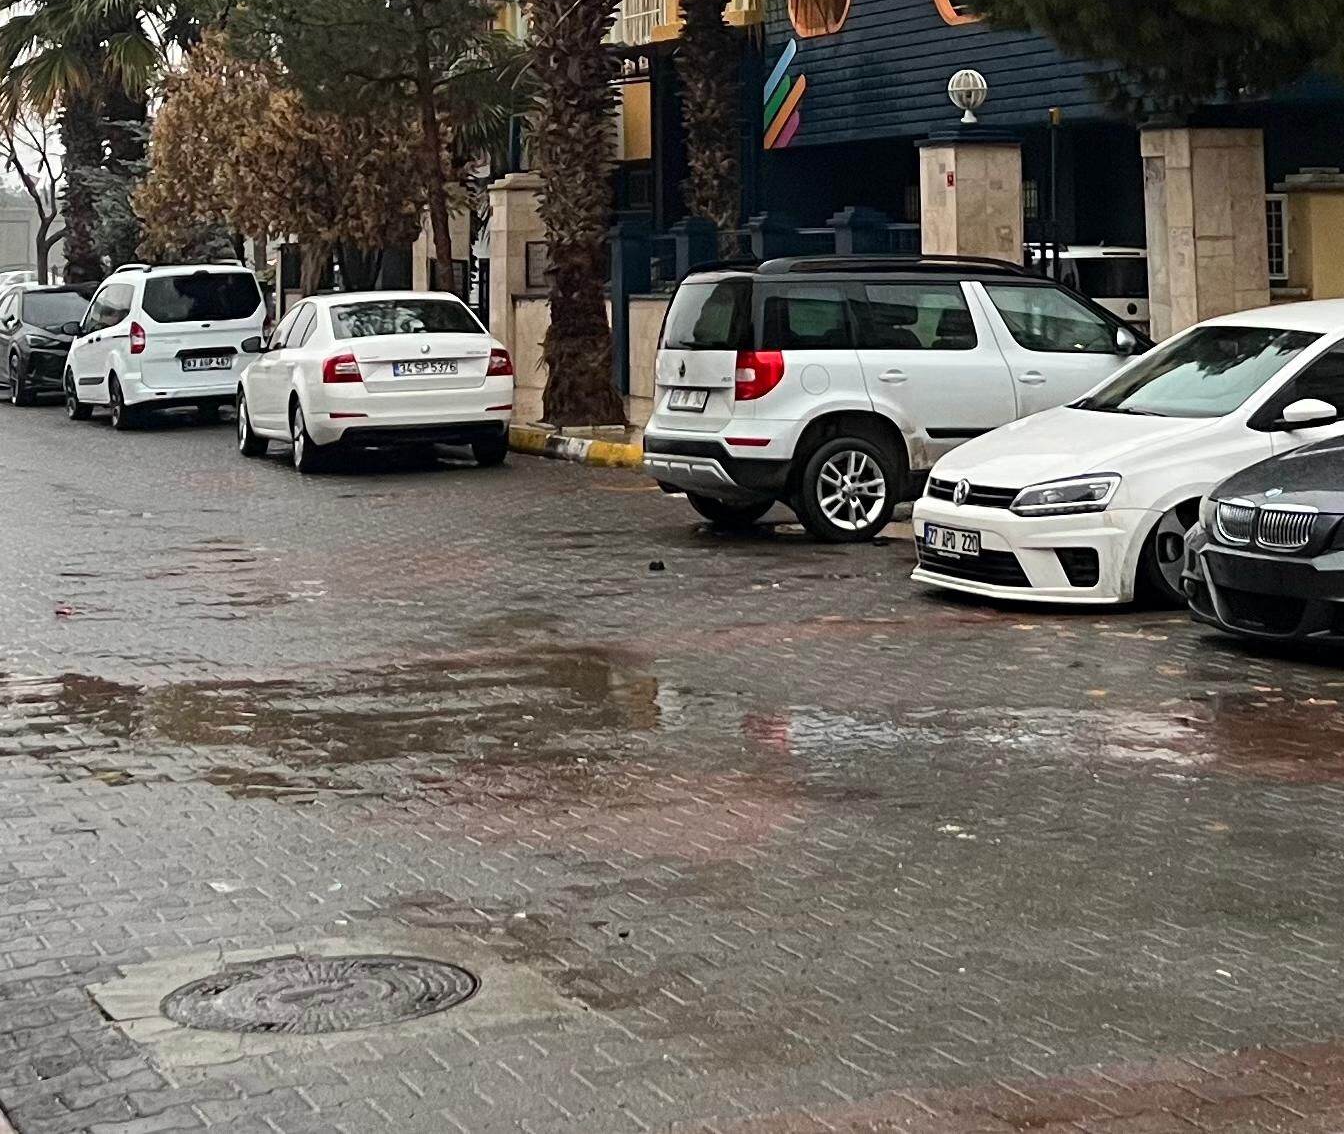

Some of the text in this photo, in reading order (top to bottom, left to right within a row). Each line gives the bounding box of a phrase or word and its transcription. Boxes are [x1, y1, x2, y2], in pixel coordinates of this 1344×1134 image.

[399, 360, 457, 374] 34 SP 5376
